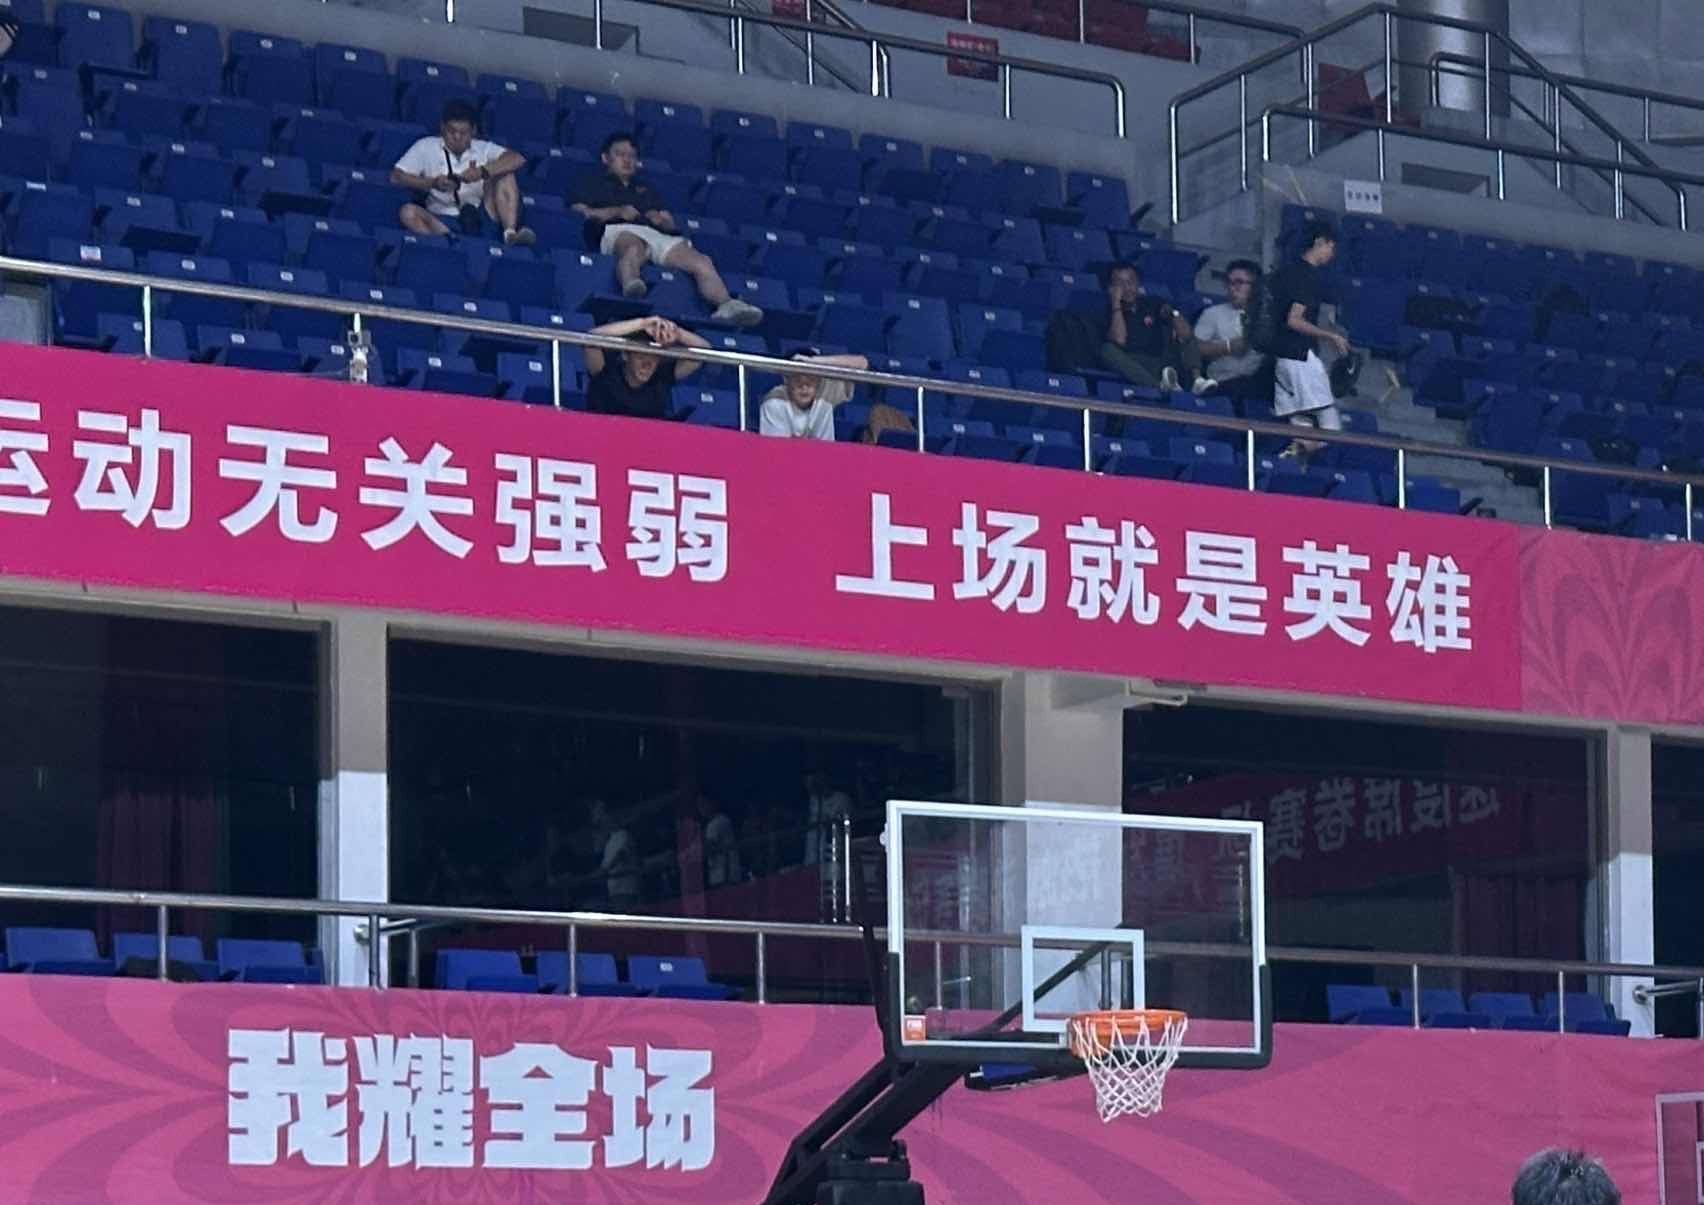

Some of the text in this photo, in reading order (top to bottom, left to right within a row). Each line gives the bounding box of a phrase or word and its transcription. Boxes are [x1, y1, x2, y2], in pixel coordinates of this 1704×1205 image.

[835, 491, 1474, 654] 上场就是英雄
[228, 1028, 716, 1172] 我耀全场
